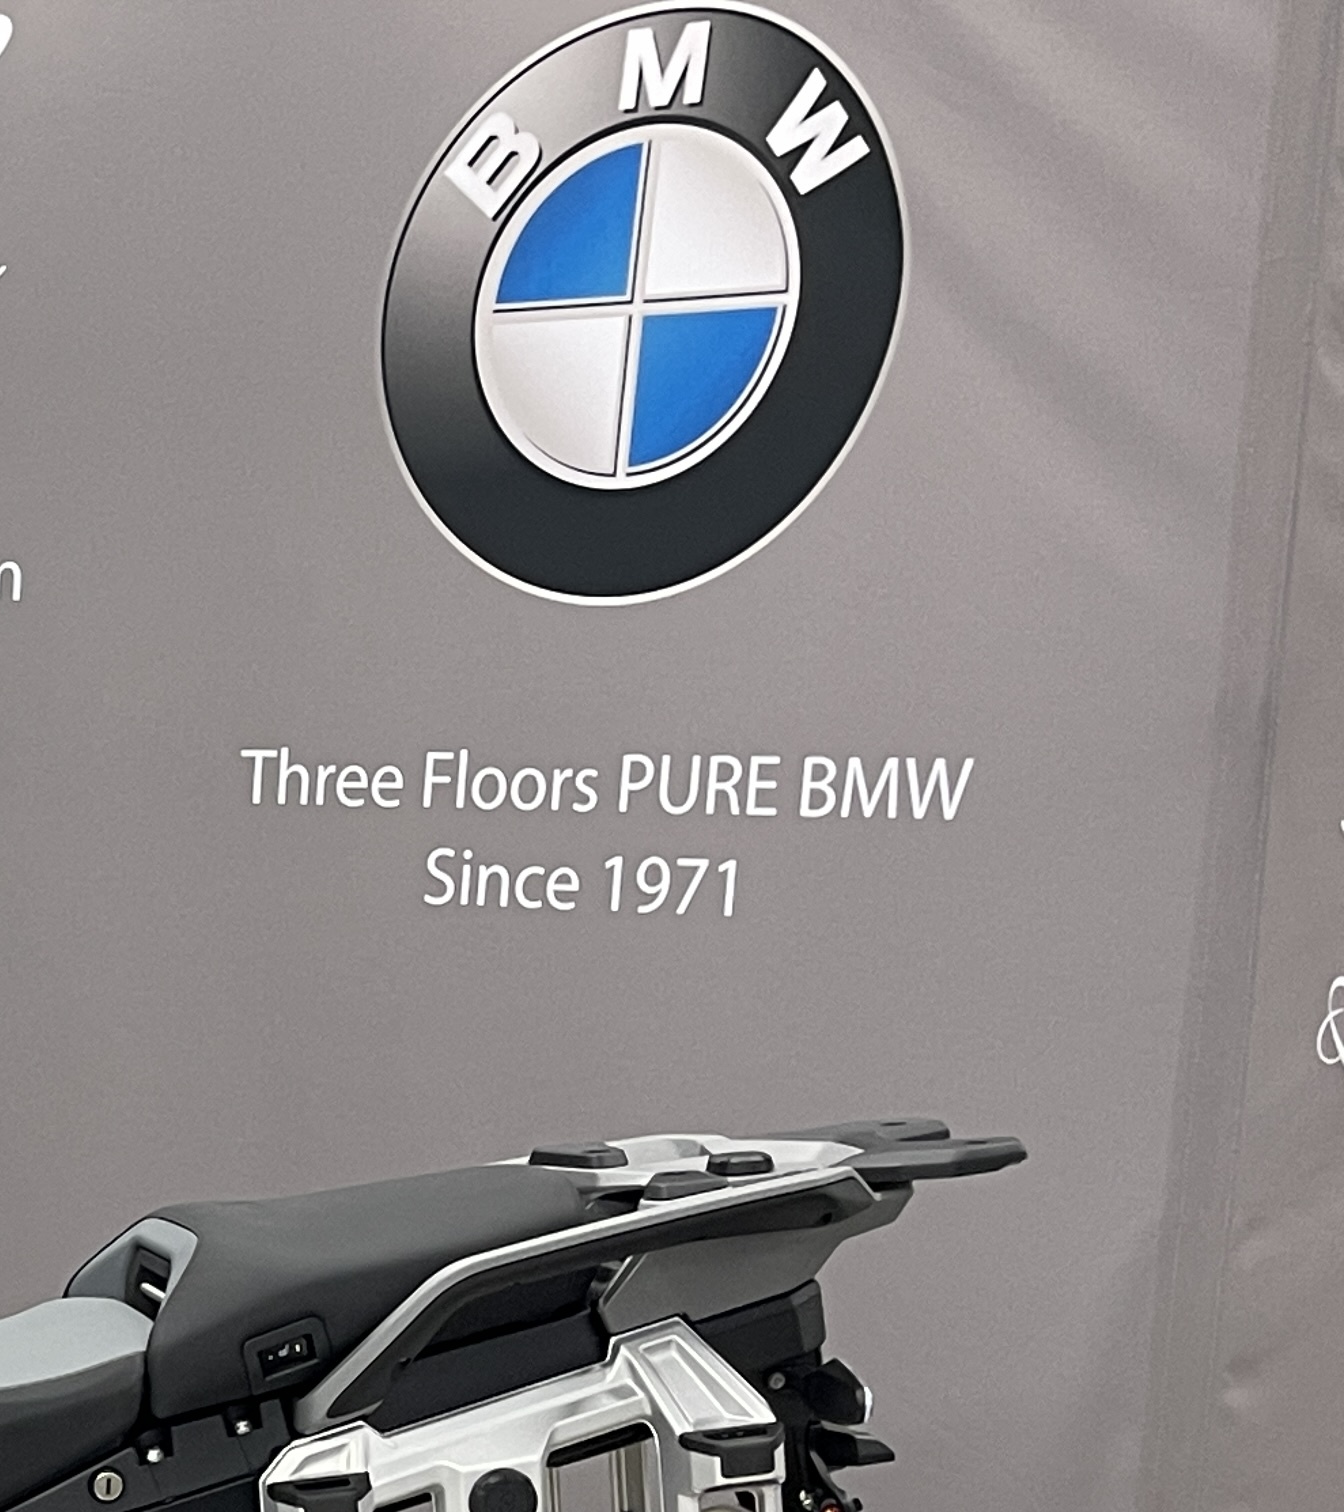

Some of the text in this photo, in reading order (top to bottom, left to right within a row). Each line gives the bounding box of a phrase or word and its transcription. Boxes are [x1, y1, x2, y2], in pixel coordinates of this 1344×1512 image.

[444, 20, 871, 222] BMW
[239, 746, 976, 822] Three Floors PURE BMW
[422, 846, 739, 918] Since 1971
